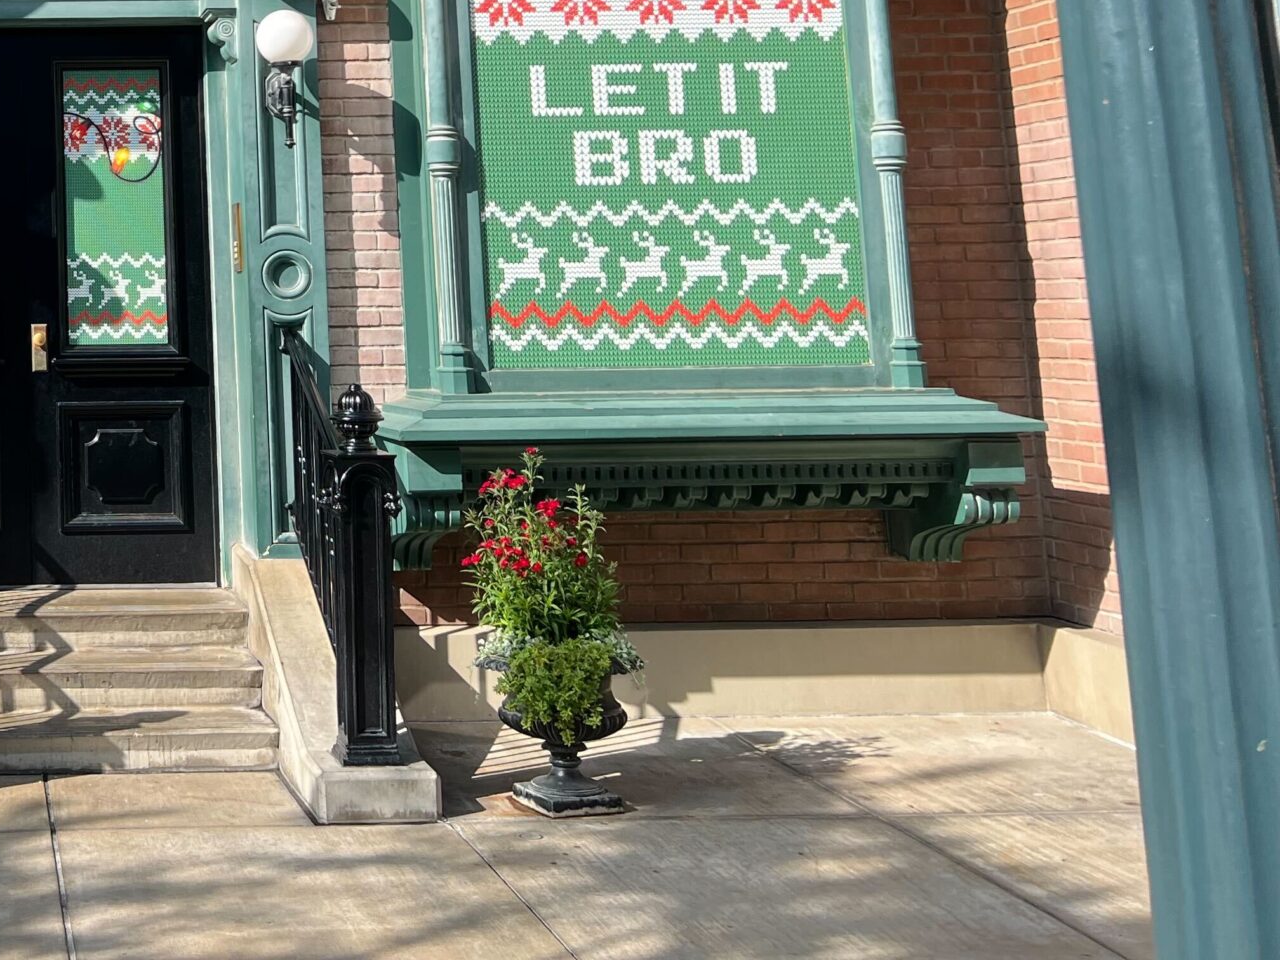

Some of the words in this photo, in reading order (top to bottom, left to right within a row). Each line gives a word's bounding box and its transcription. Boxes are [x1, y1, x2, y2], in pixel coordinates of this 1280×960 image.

[529, 62, 697, 116] LET
[719, 61, 789, 115] IT
[573, 129, 758, 186] BRO
